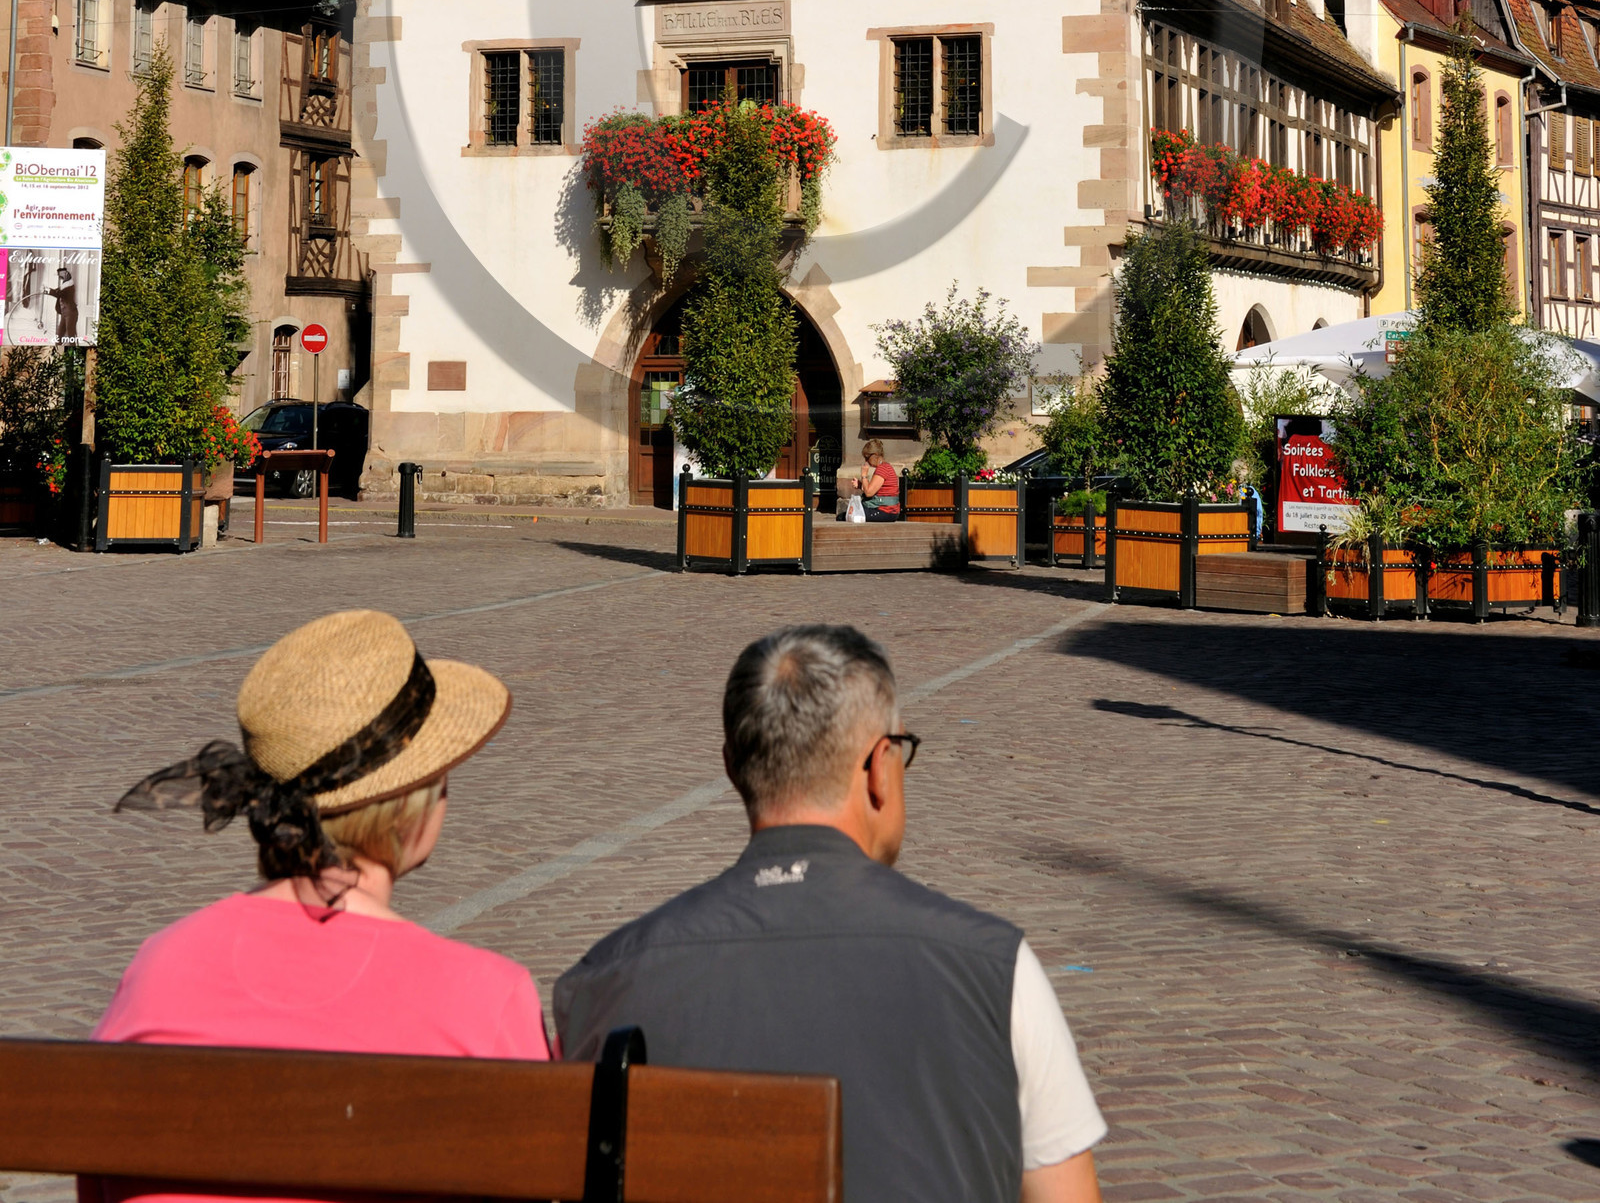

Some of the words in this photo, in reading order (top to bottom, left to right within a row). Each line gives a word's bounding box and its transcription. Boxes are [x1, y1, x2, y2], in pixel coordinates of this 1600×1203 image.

[15, 163, 97, 177] BiObernai'12
[25, 204, 39, 212] Agir
[13, 208, 95, 221] l'environnement
[19, 335, 48, 343] Culture
[1283, 443, 1324, 457] Soirées
[1293, 463, 1336, 478] Folklore
[1302, 486, 1315, 498] et
[1300, 512, 1312, 520] juillet
